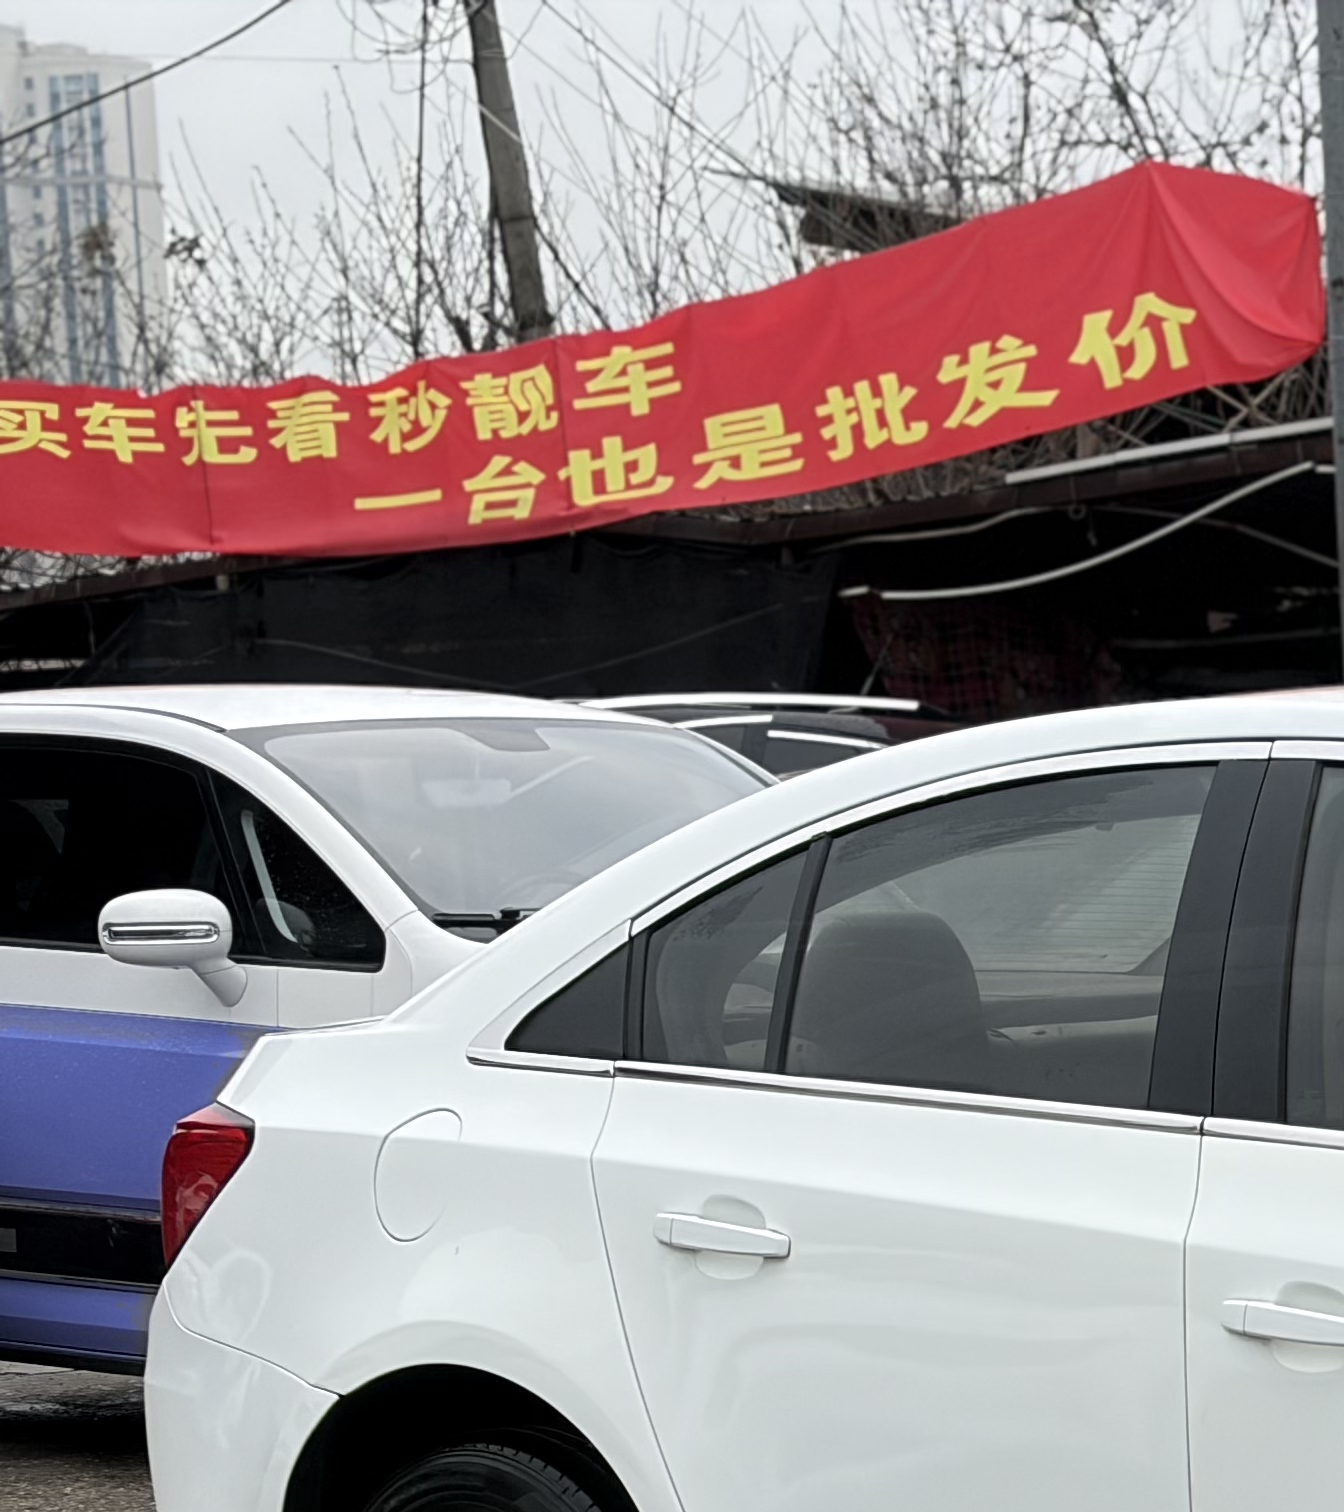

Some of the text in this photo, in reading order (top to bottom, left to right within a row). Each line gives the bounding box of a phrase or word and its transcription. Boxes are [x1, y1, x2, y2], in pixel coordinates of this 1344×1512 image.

[0, 341, 682, 466] 买车先看秒靓车
[354, 291, 1197, 524] 一台也是批发价
